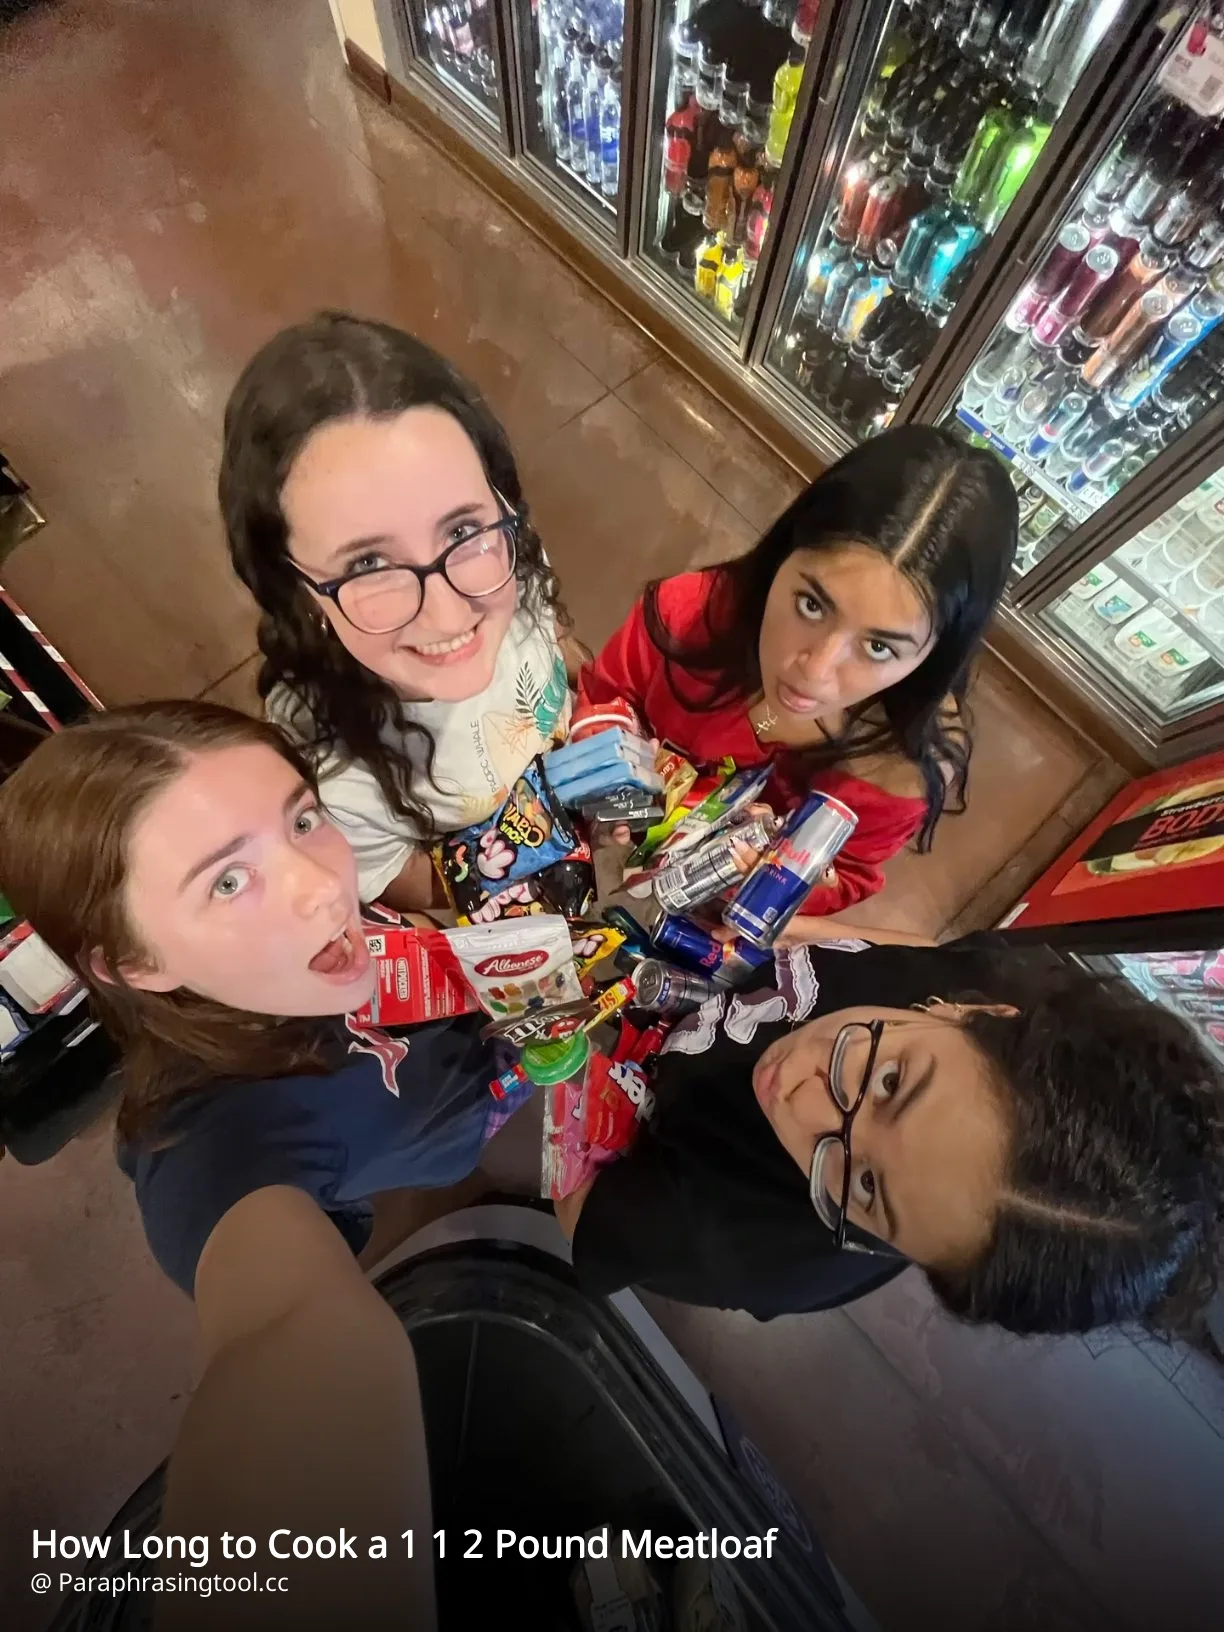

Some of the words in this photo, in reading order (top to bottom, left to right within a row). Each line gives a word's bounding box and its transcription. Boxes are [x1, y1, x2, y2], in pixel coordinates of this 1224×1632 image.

[470, 719, 484, 755] WHALE
[500, 822, 524, 845] SOUR
[699, 942, 723, 967] Red
